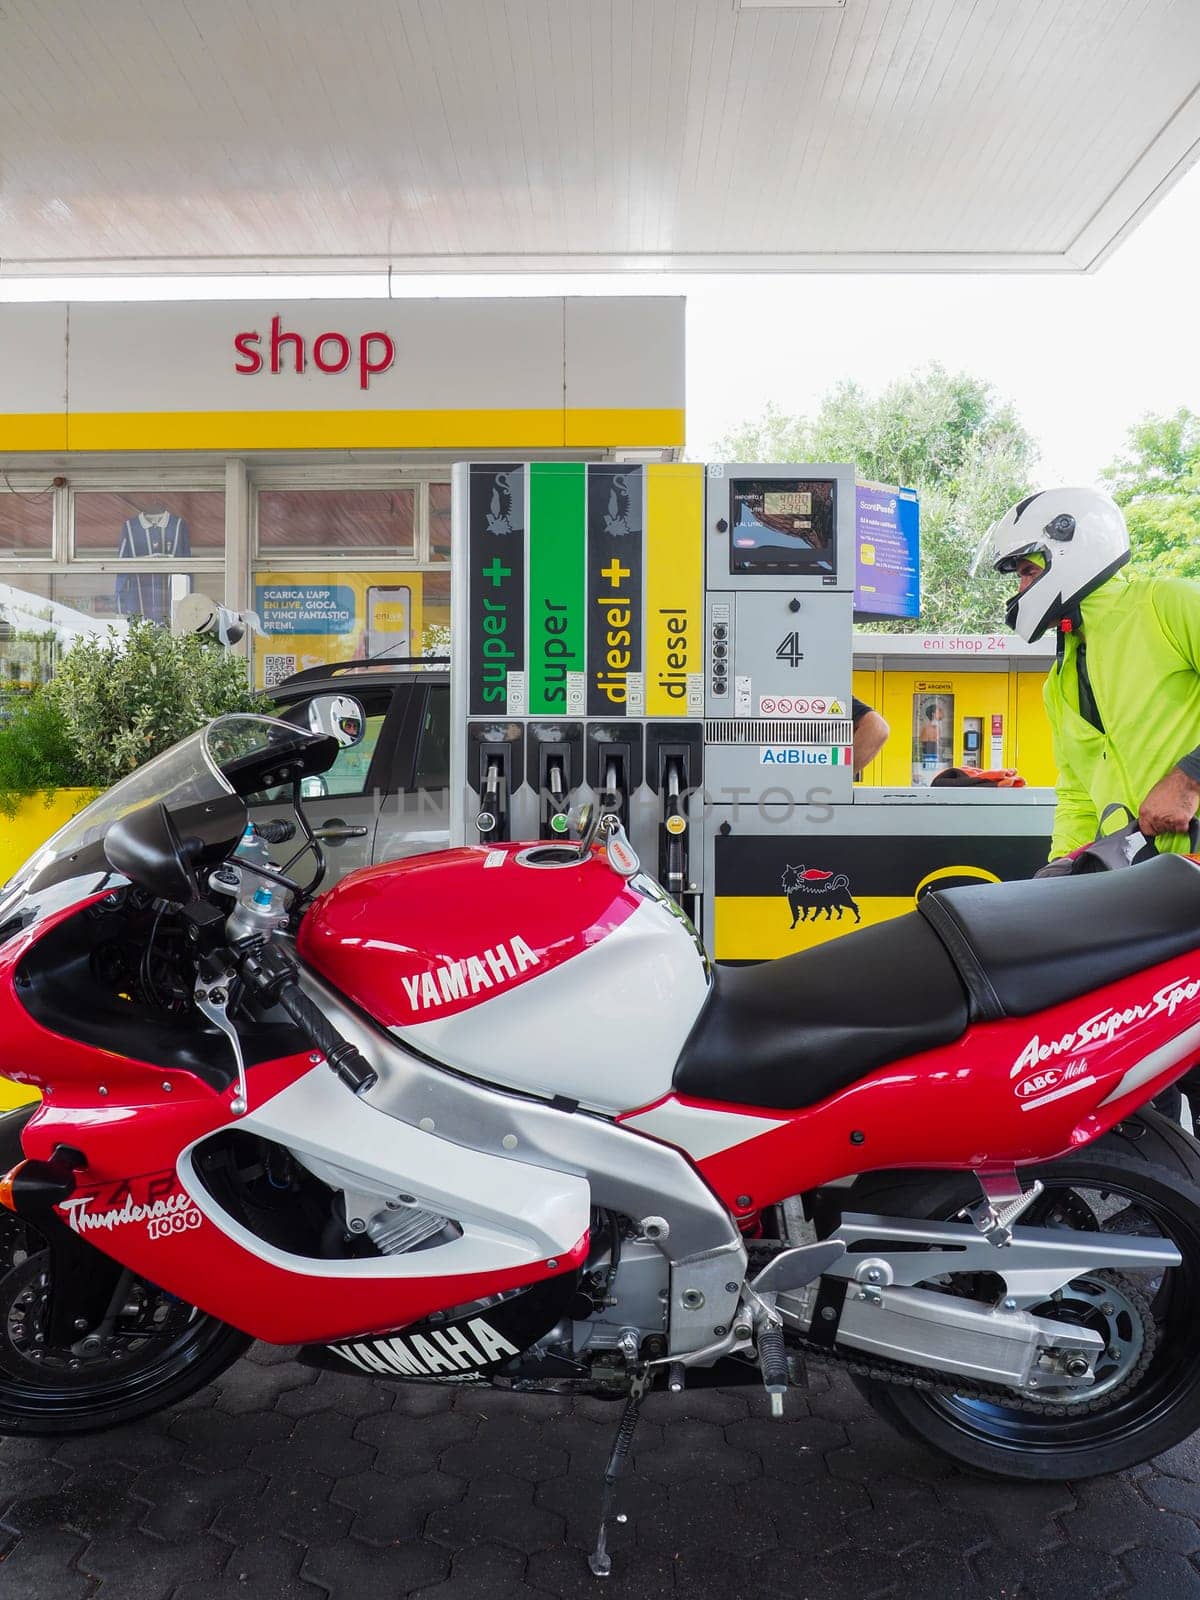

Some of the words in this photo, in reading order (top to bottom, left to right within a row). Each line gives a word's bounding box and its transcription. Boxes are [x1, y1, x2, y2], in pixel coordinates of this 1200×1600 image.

[234, 313, 395, 390] shop
[263, 591, 304, 599] SCARICA
[306, 591, 330, 599] L'APP
[263, 601, 280, 609] ENI
[282, 601, 303, 611] LIVE,
[305, 601, 336, 609] GIOCA
[263, 611, 269, 619] E
[271, 611, 297, 619] VINCI
[298, 611, 349, 619] FANTASTICI
[263, 621, 294, 630] PREMI.
[482, 598, 516, 702] super
[544, 598, 576, 702] super
[597, 598, 631, 703] diesel
[659, 609, 687, 698] diesel
[776, 632, 804, 668] 4
[923, 638, 944, 650] eni
[949, 638, 983, 652] shop
[987, 637, 1006, 650] 24
[763, 749, 828, 764] AdBlue
[401, 935, 540, 1011] YAMAHA
[1023, 1071, 1058, 1095] ABC
[59, 1193, 191, 1234] Thunderace
[147, 1208, 202, 1240] 1000
[326, 1317, 520, 1375] YAMAHA
